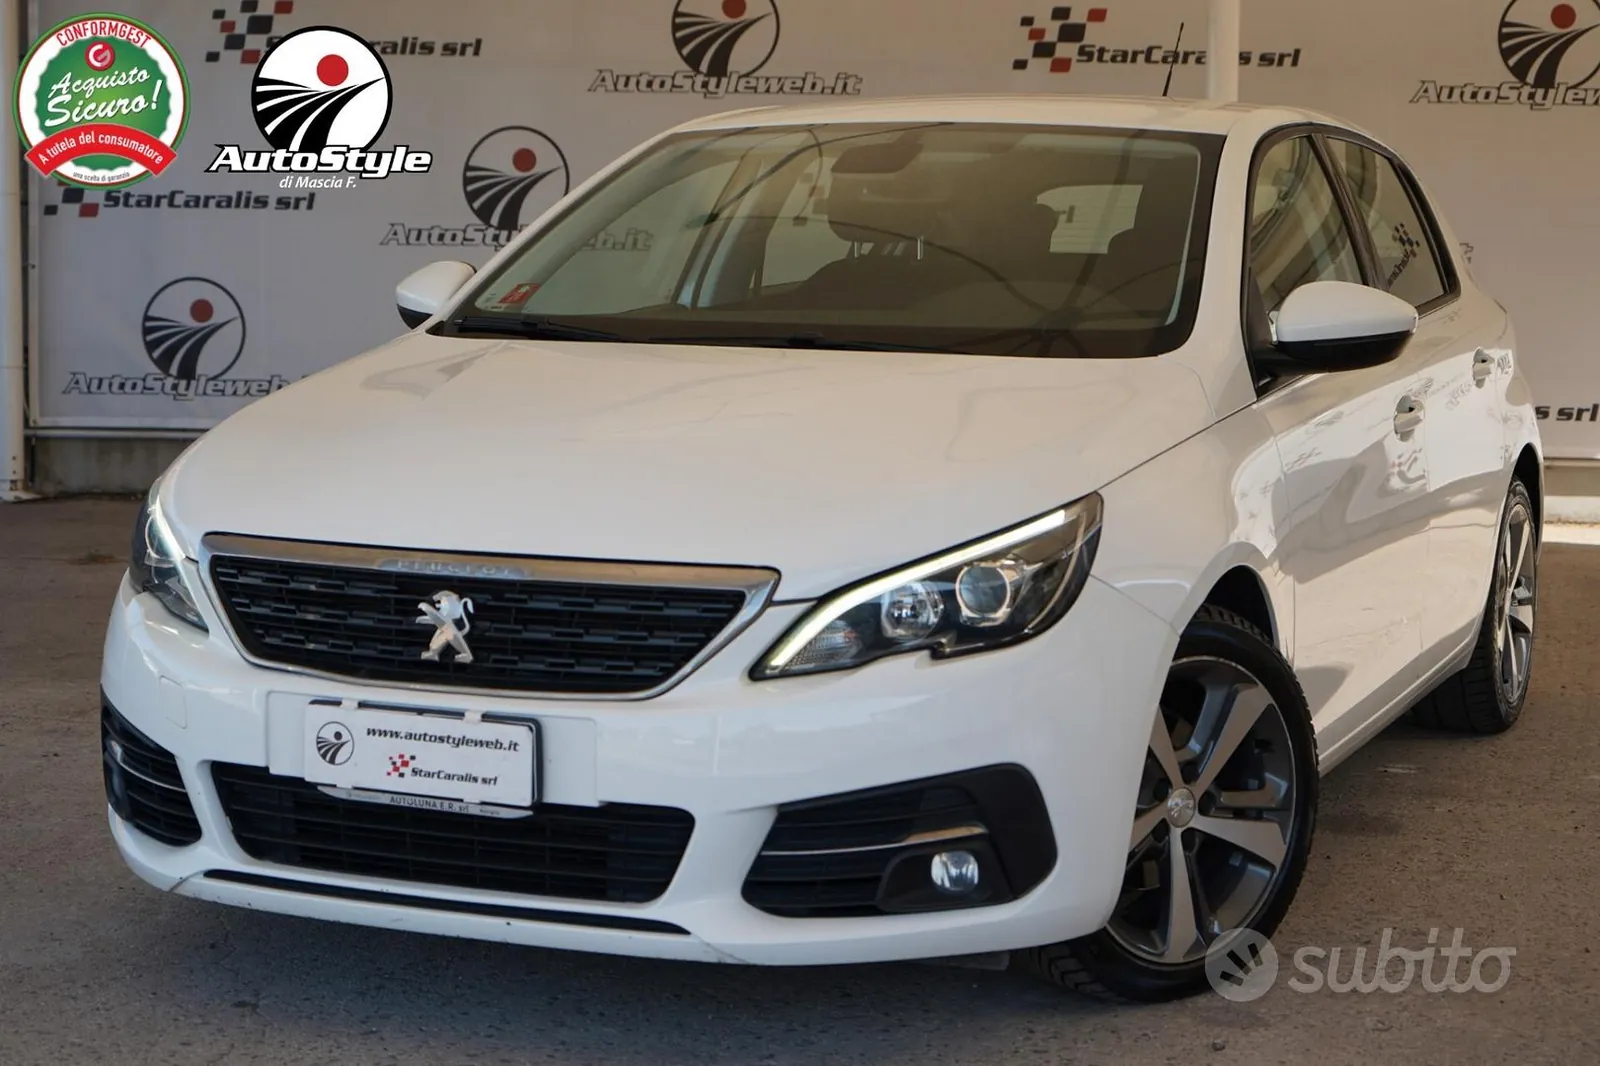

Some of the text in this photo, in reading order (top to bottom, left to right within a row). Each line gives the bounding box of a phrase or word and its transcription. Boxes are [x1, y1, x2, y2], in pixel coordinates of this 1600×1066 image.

[440, 38, 483, 57] srl
[1076, 44, 1302, 68] StarCaras srl
[587, 69, 863, 99] AutoStyleweb.it
[103, 190, 316, 211] StarCaralis srl
[1556, 403, 1600, 422] srl
[366, 727, 520, 752] www.autostyleweb.it
[410, 767, 498, 786] StarCaralis srl
[390, 796, 437, 809] AUTOLUNA
